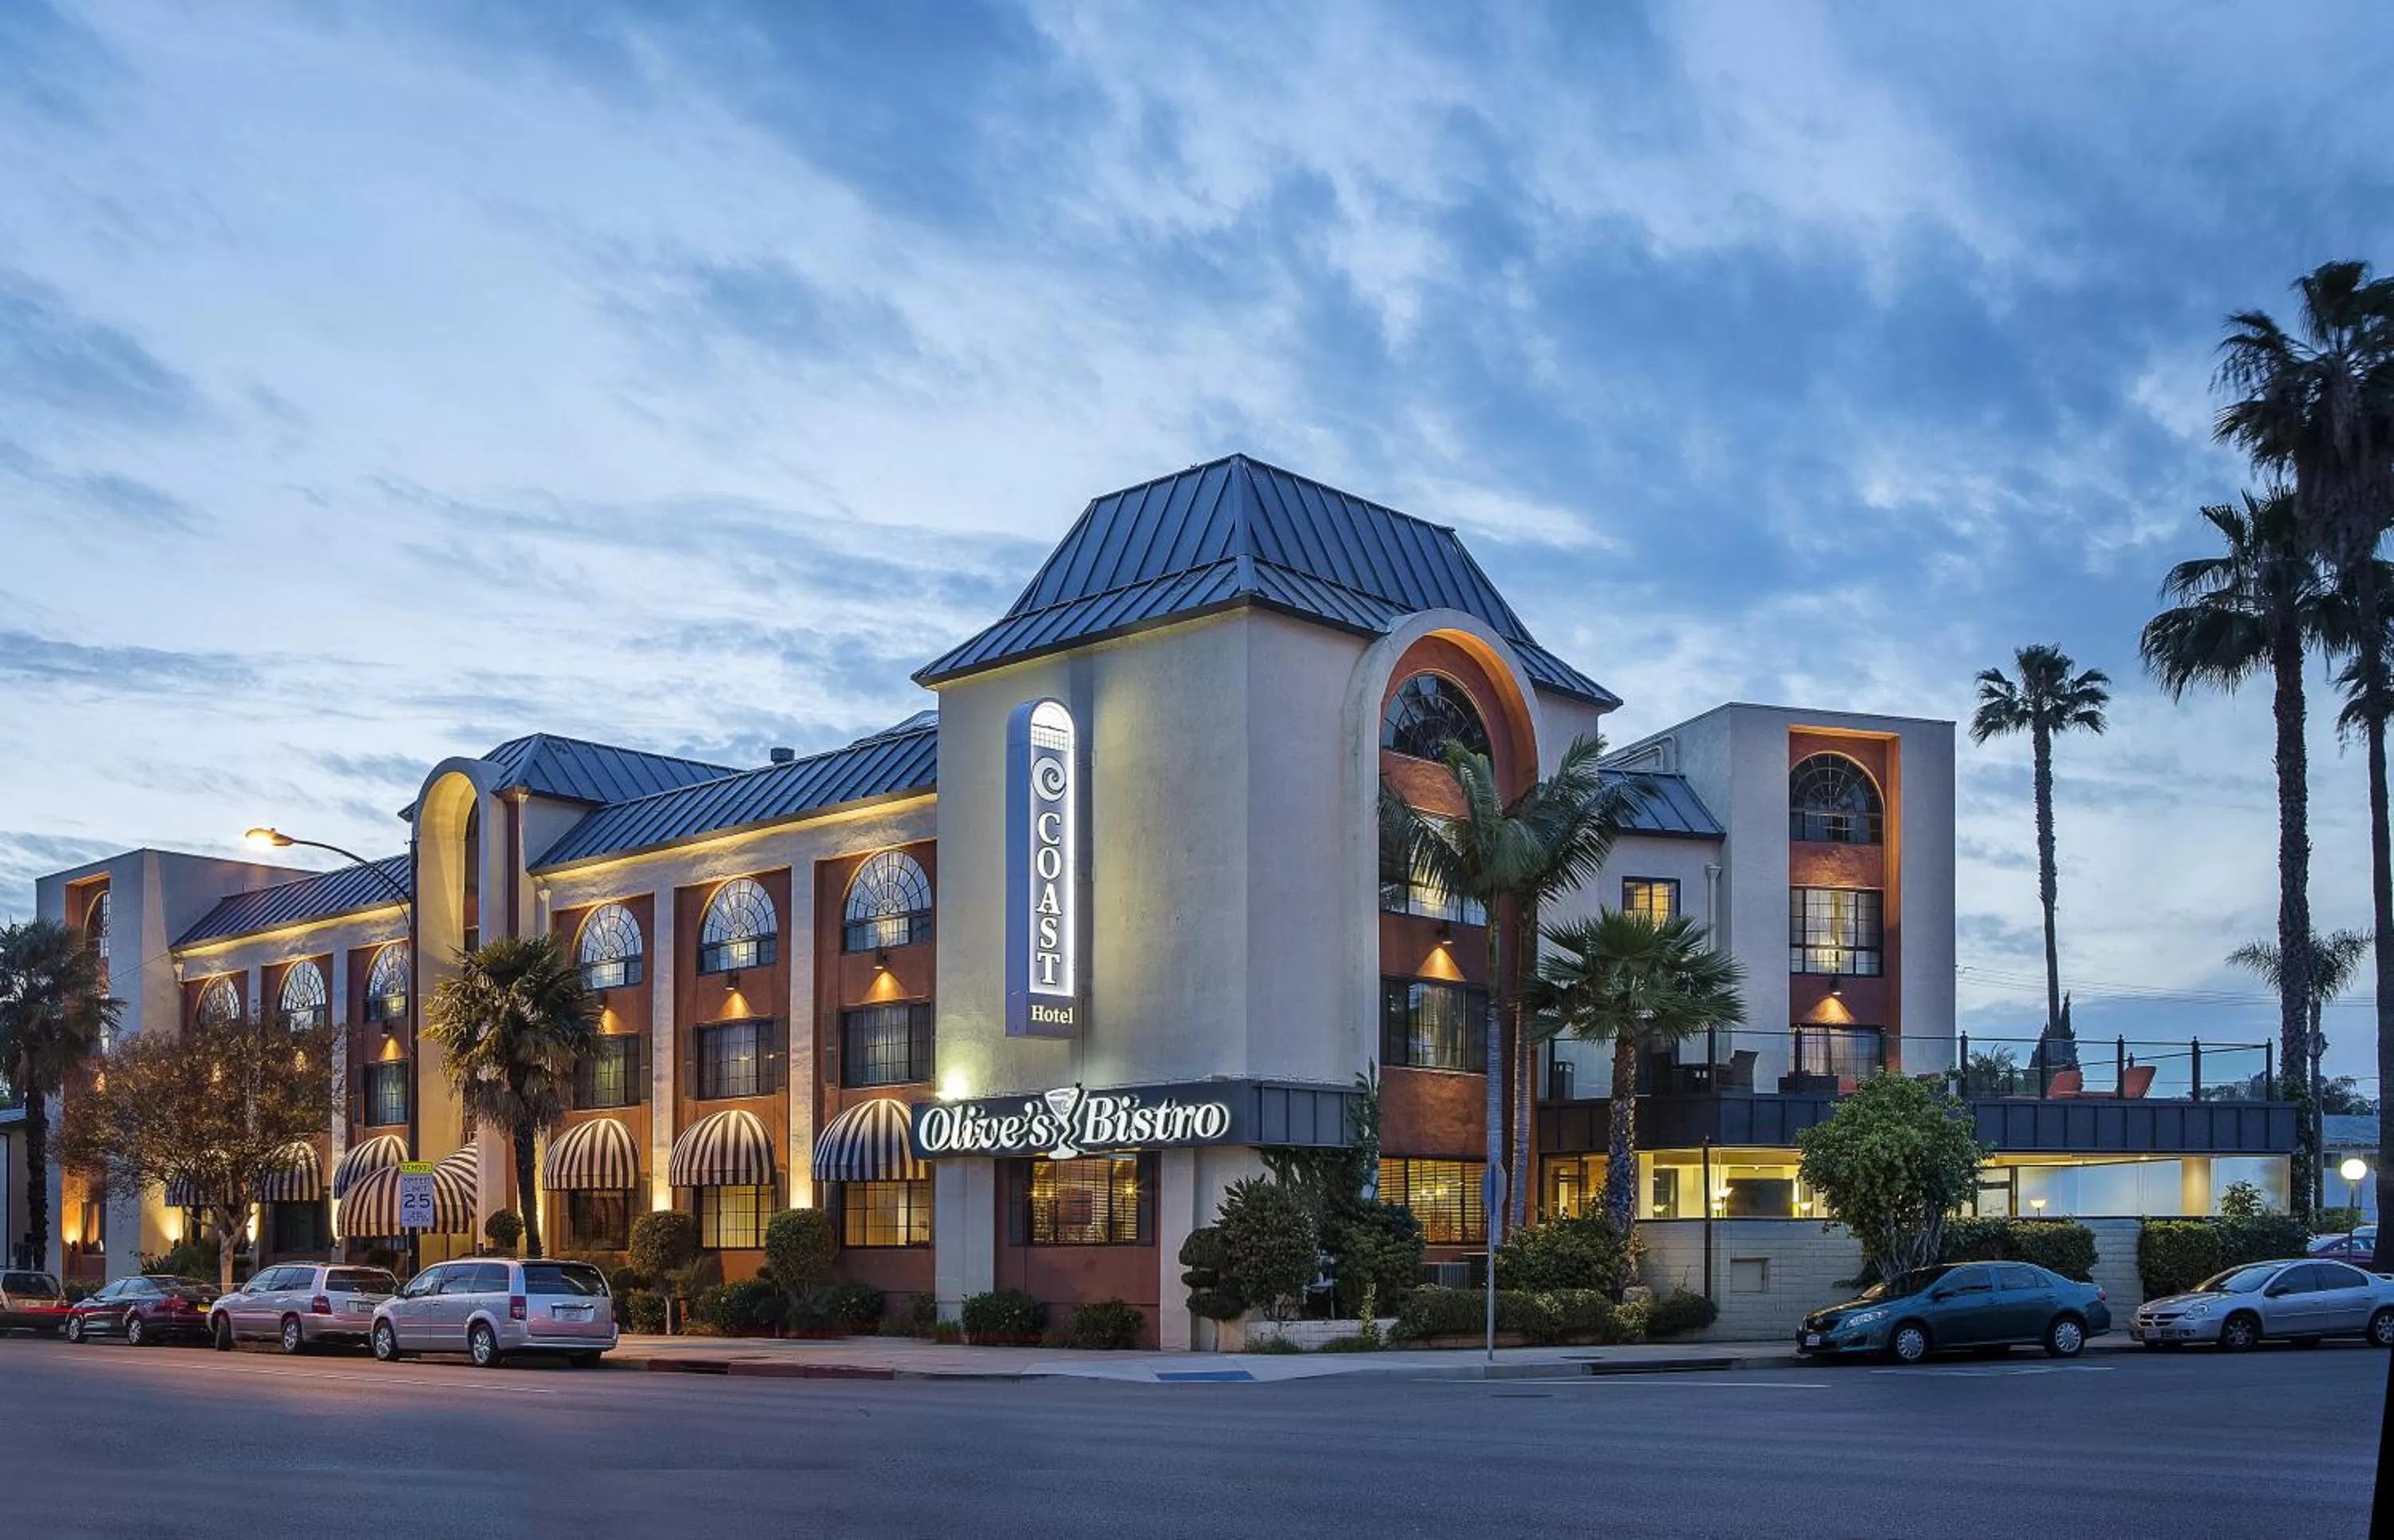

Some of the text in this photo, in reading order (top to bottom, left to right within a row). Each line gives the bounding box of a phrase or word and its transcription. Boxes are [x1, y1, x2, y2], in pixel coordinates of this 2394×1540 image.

[1036, 811, 1062, 986] COAST
[1030, 1005, 1073, 1025] Hotel
[919, 1095, 1231, 1151] Olive's Bistro
[401, 1163, 432, 1172] SCHOOL
[404, 1193, 430, 1209] 25
